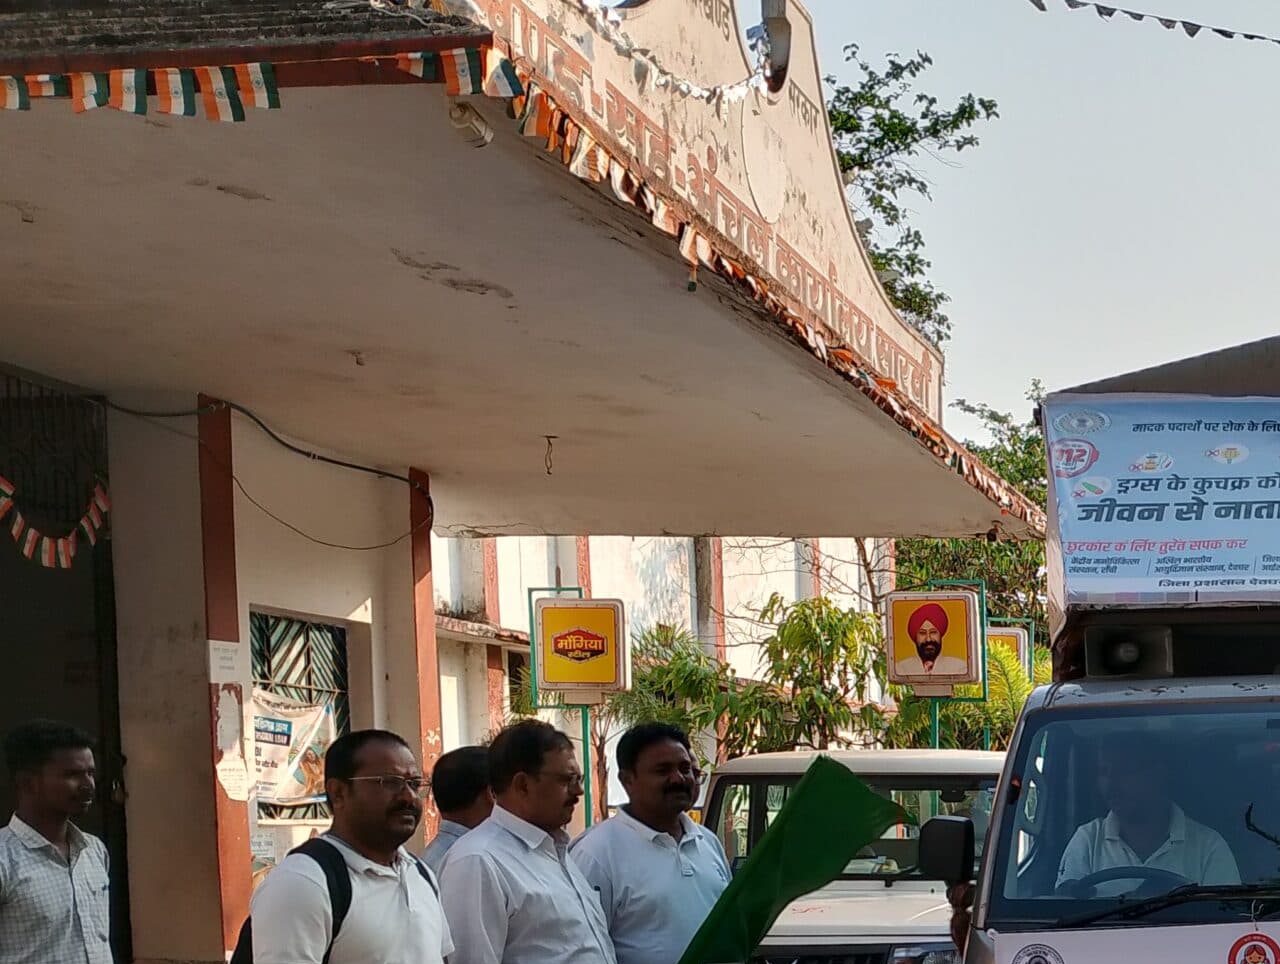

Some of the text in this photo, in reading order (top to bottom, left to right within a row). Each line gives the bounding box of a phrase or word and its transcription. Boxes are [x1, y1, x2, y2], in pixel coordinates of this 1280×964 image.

[1132, 422, 1165, 433] मादक
[1204, 422, 1219, 432] पर
[1222, 420, 1247, 432] रोक
[1247, 420, 1260, 432] के
[1166, 474, 1190, 491] के
[1193, 476, 1253, 495] कुचक्र
[1077, 498, 1169, 522] जीवन
[1174, 496, 1209, 521] से
[1159, 579, 1190, 587] जिला
[557, 635, 602, 650] मोंगिया
